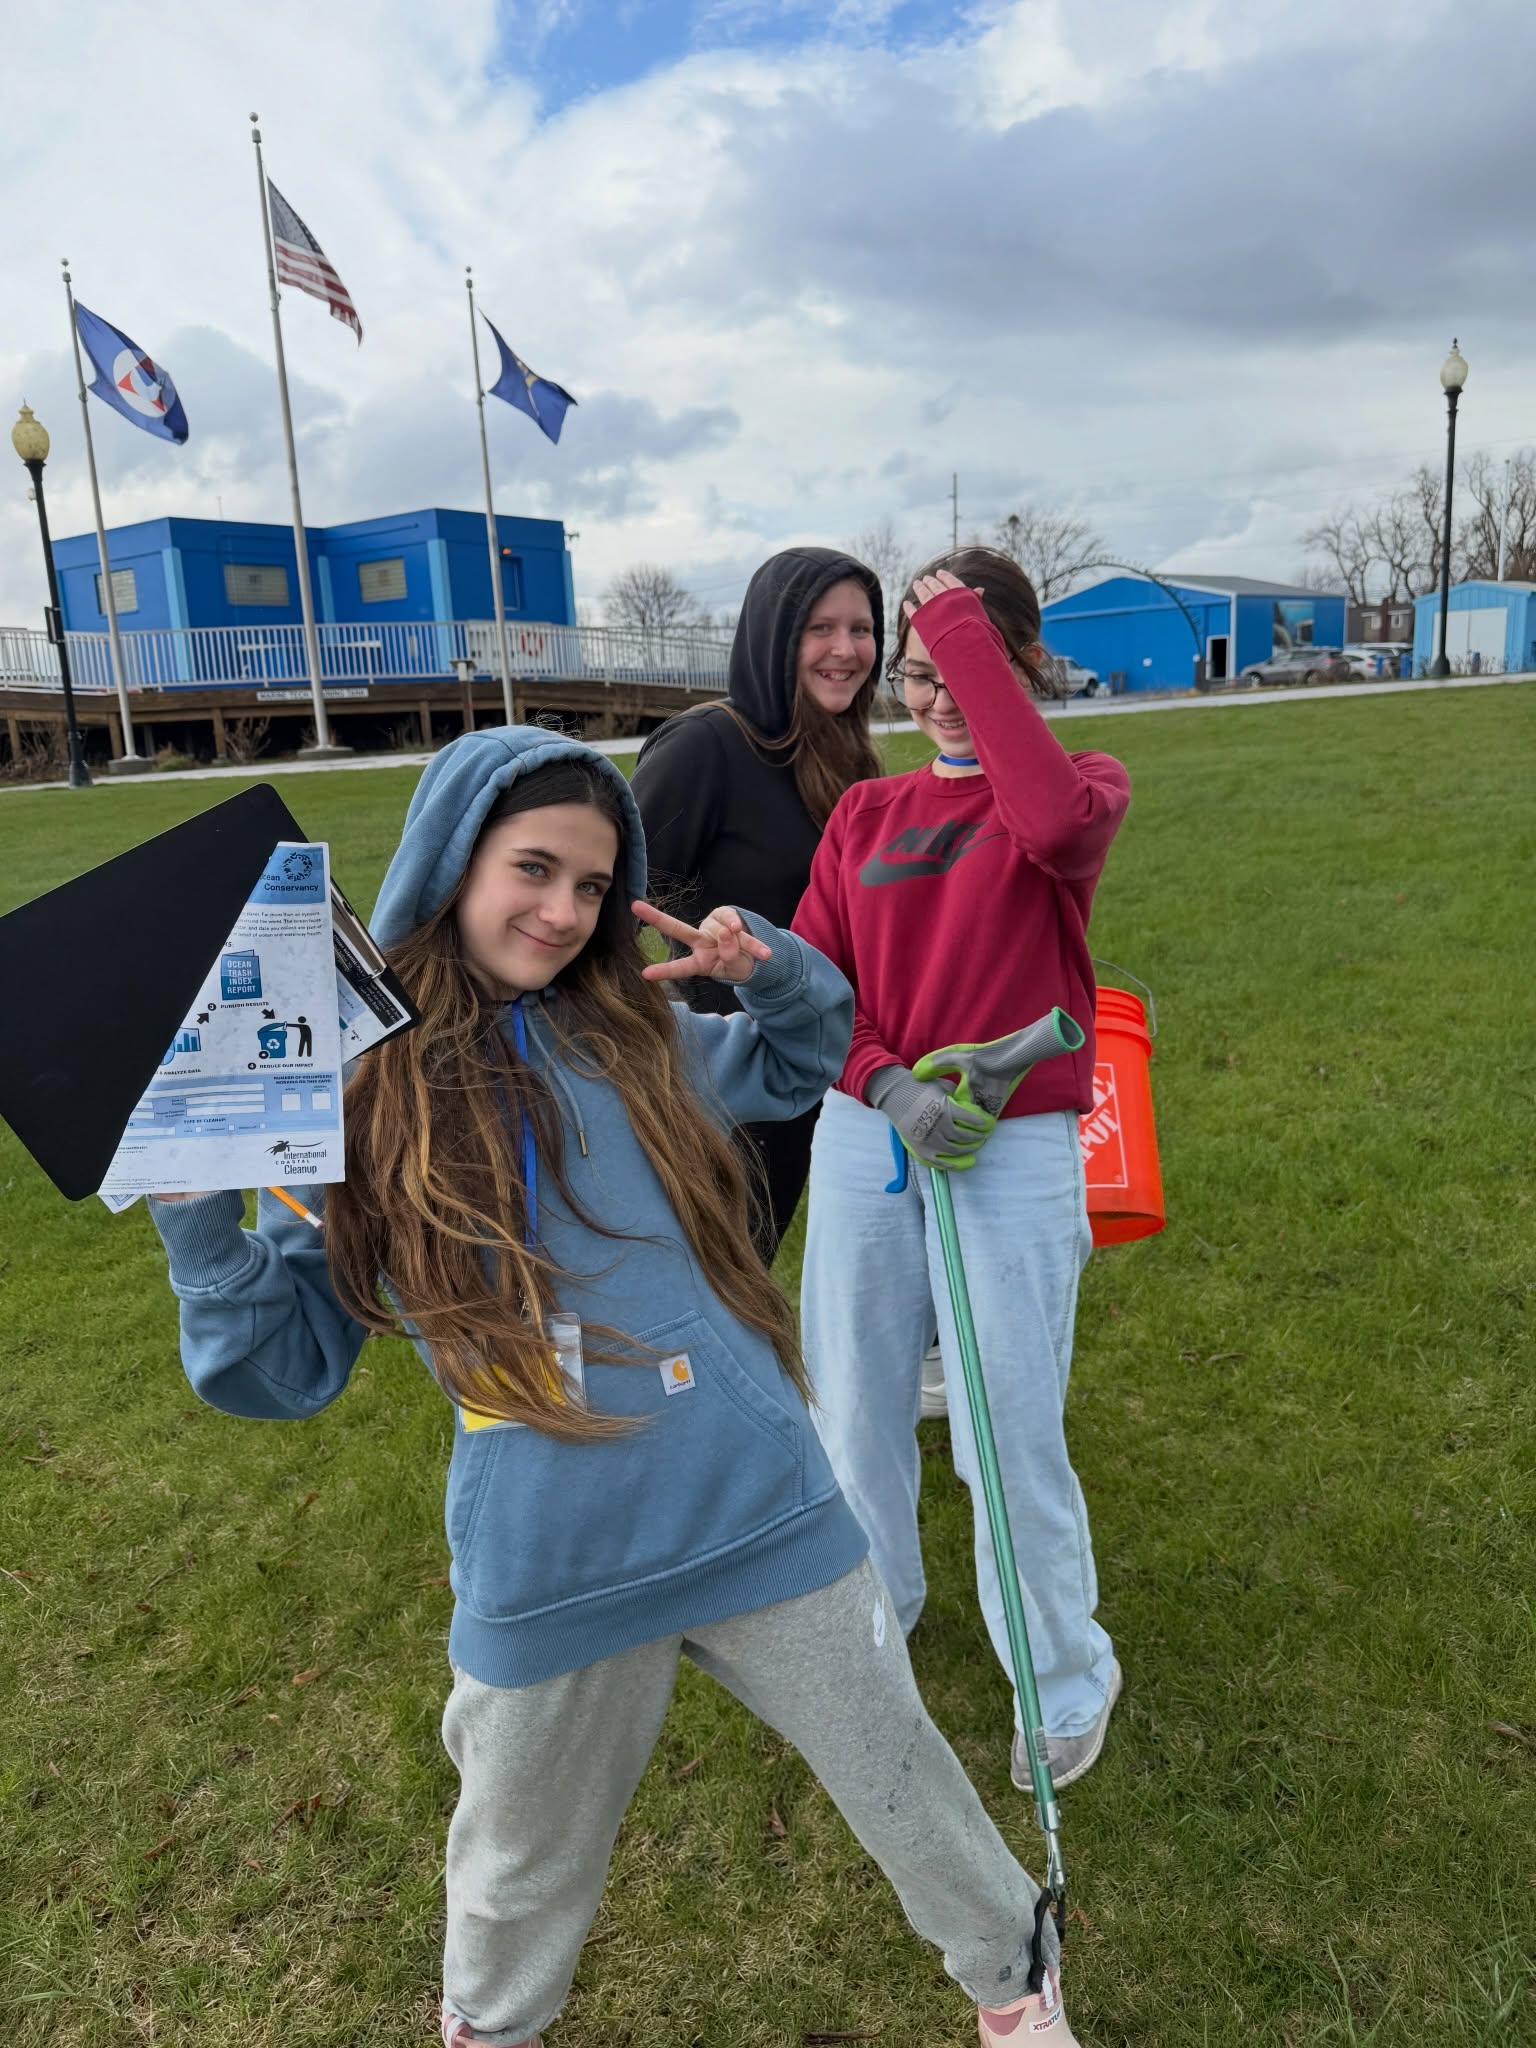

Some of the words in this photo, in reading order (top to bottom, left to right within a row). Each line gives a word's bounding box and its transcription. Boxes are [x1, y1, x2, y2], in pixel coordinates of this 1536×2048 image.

[264, 884, 319, 892] Conservancy
[227, 960, 252, 968] OCEAN
[227, 969, 253, 977] TRASH
[229, 977, 253, 985] INDEX
[227, 985, 256, 994] REPORT
[283, 1150, 327, 1160] International
[284, 1164, 317, 1175] Cleanup
